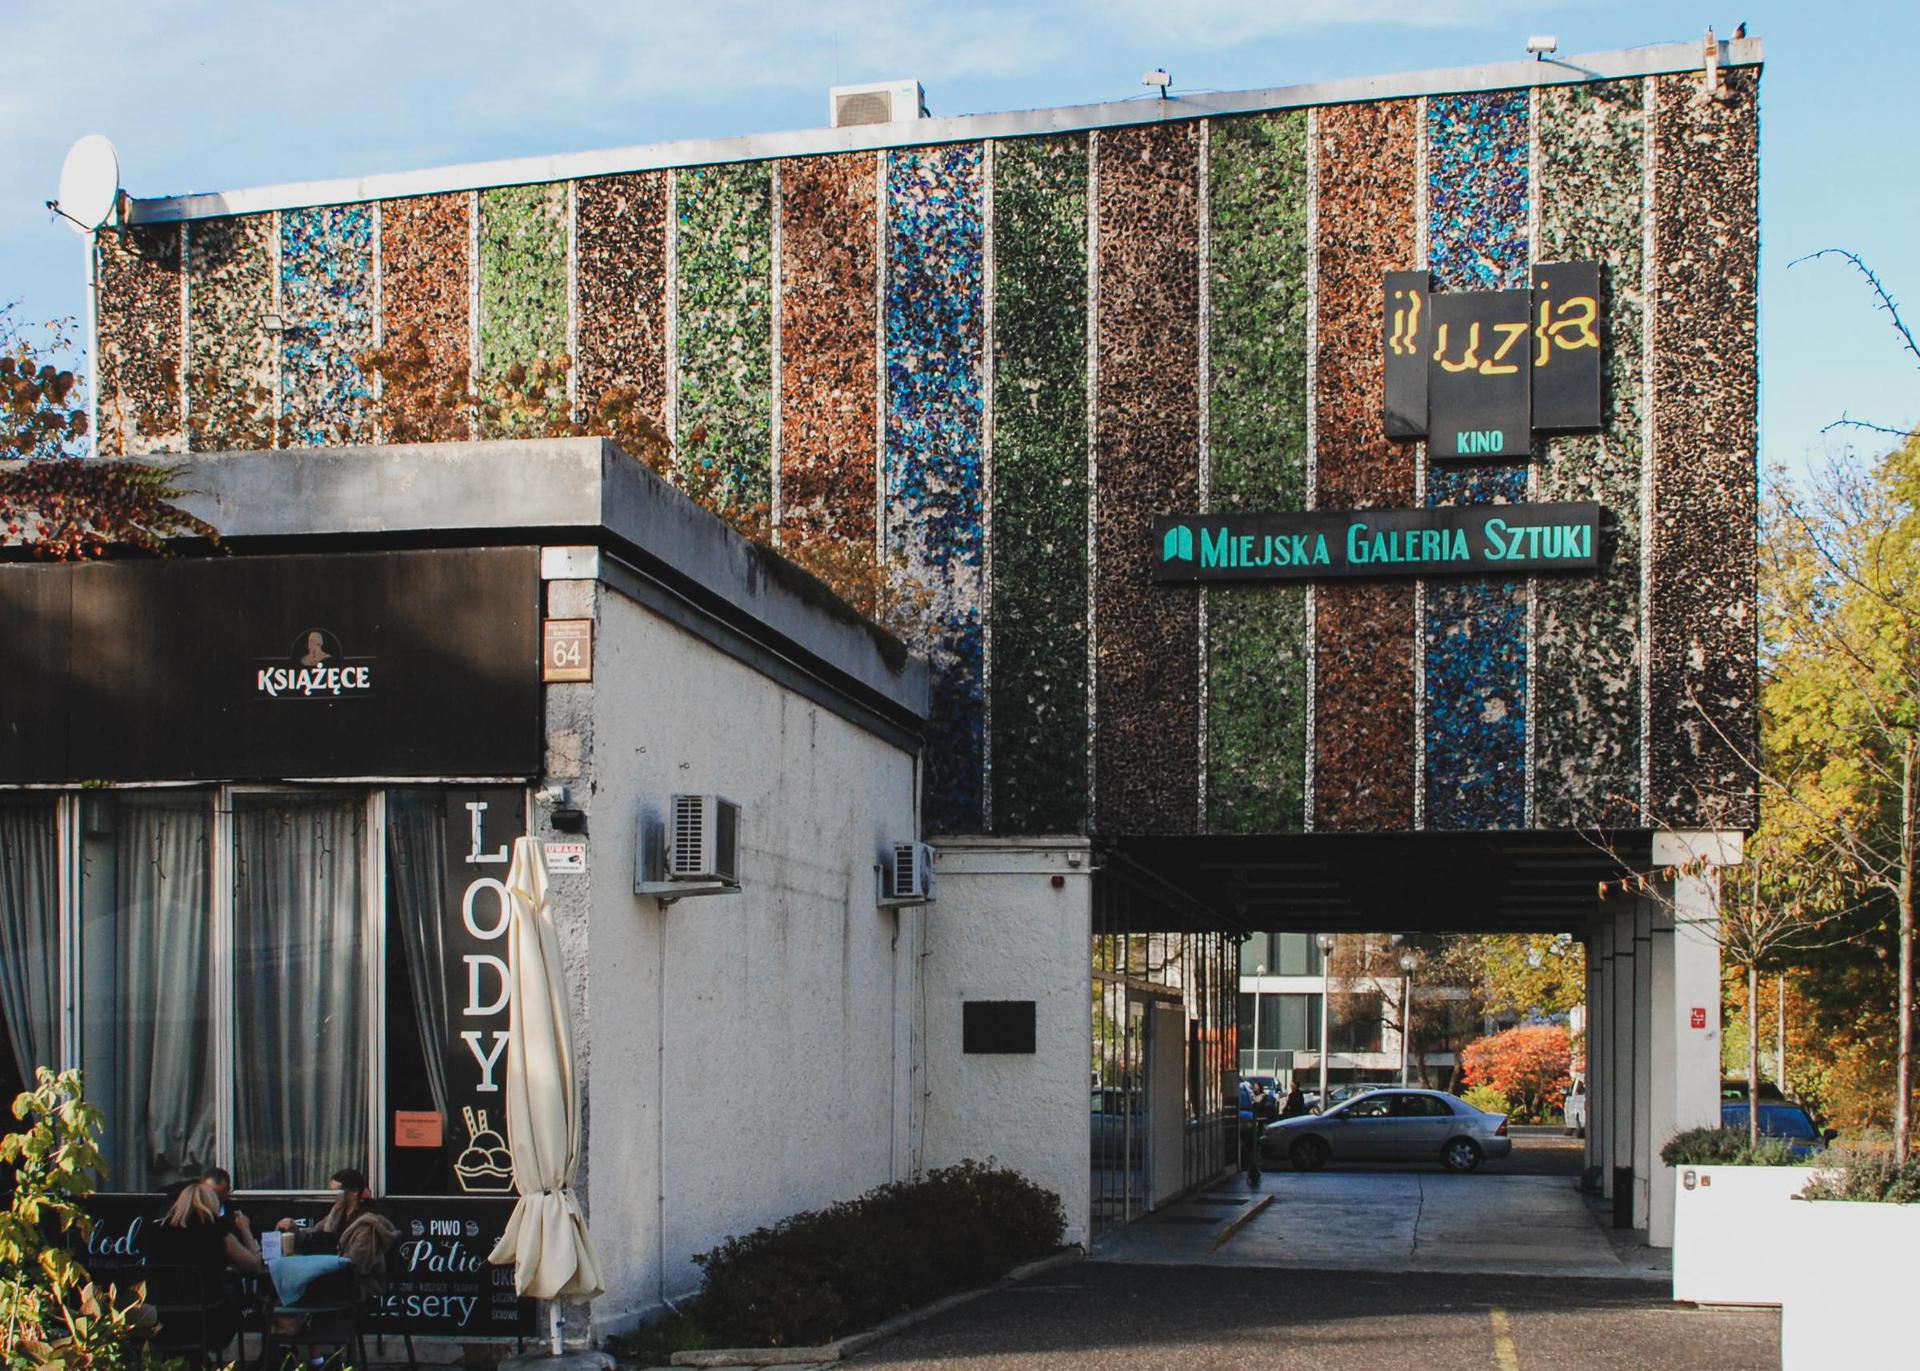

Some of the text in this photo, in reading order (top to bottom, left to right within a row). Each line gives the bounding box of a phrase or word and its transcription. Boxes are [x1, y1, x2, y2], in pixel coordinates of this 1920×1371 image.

[1457, 431, 1504, 454] KINO
[1200, 518, 1592, 569] MIEJSKA GALERIA SZTUKI
[552, 640, 581, 667] 64
[257, 662, 370, 697] KSIĄŻĘCE
[460, 801, 512, 1093] LODY
[87, 1215, 147, 1266] lod
[430, 1220, 460, 1236] PIWO
[400, 1240, 487, 1272] Patio
